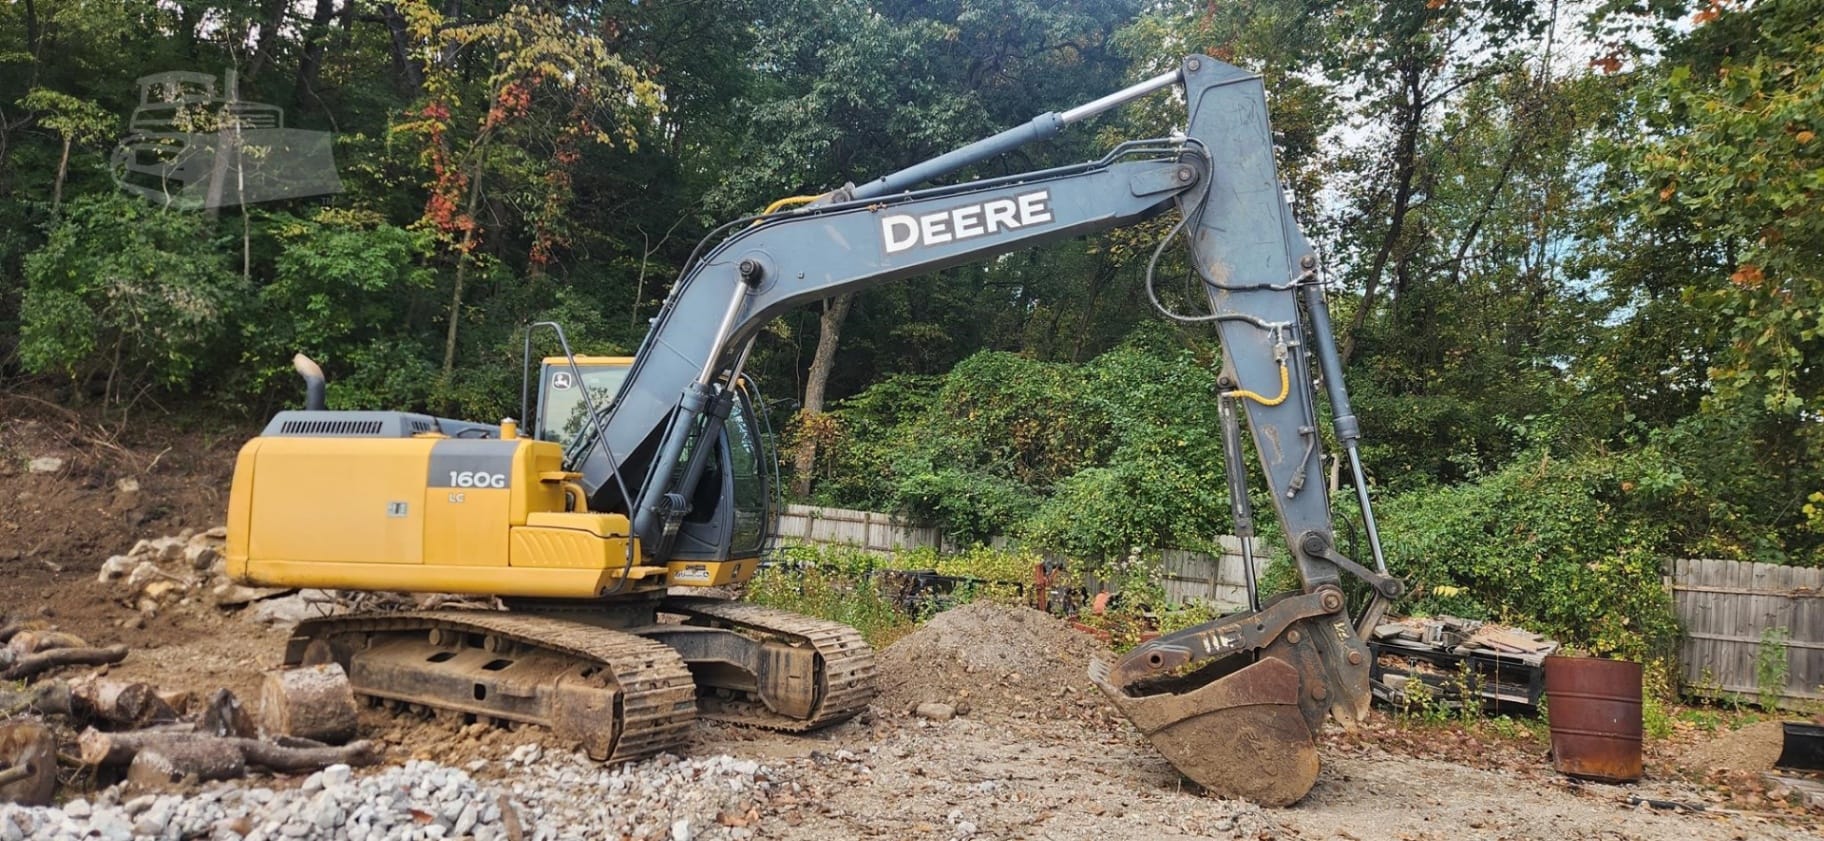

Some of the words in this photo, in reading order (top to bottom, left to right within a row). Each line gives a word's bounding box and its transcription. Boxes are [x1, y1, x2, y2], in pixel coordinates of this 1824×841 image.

[881, 190, 1052, 253] DEERE
[449, 470, 505, 488] 160G
[448, 493, 465, 503] LC
